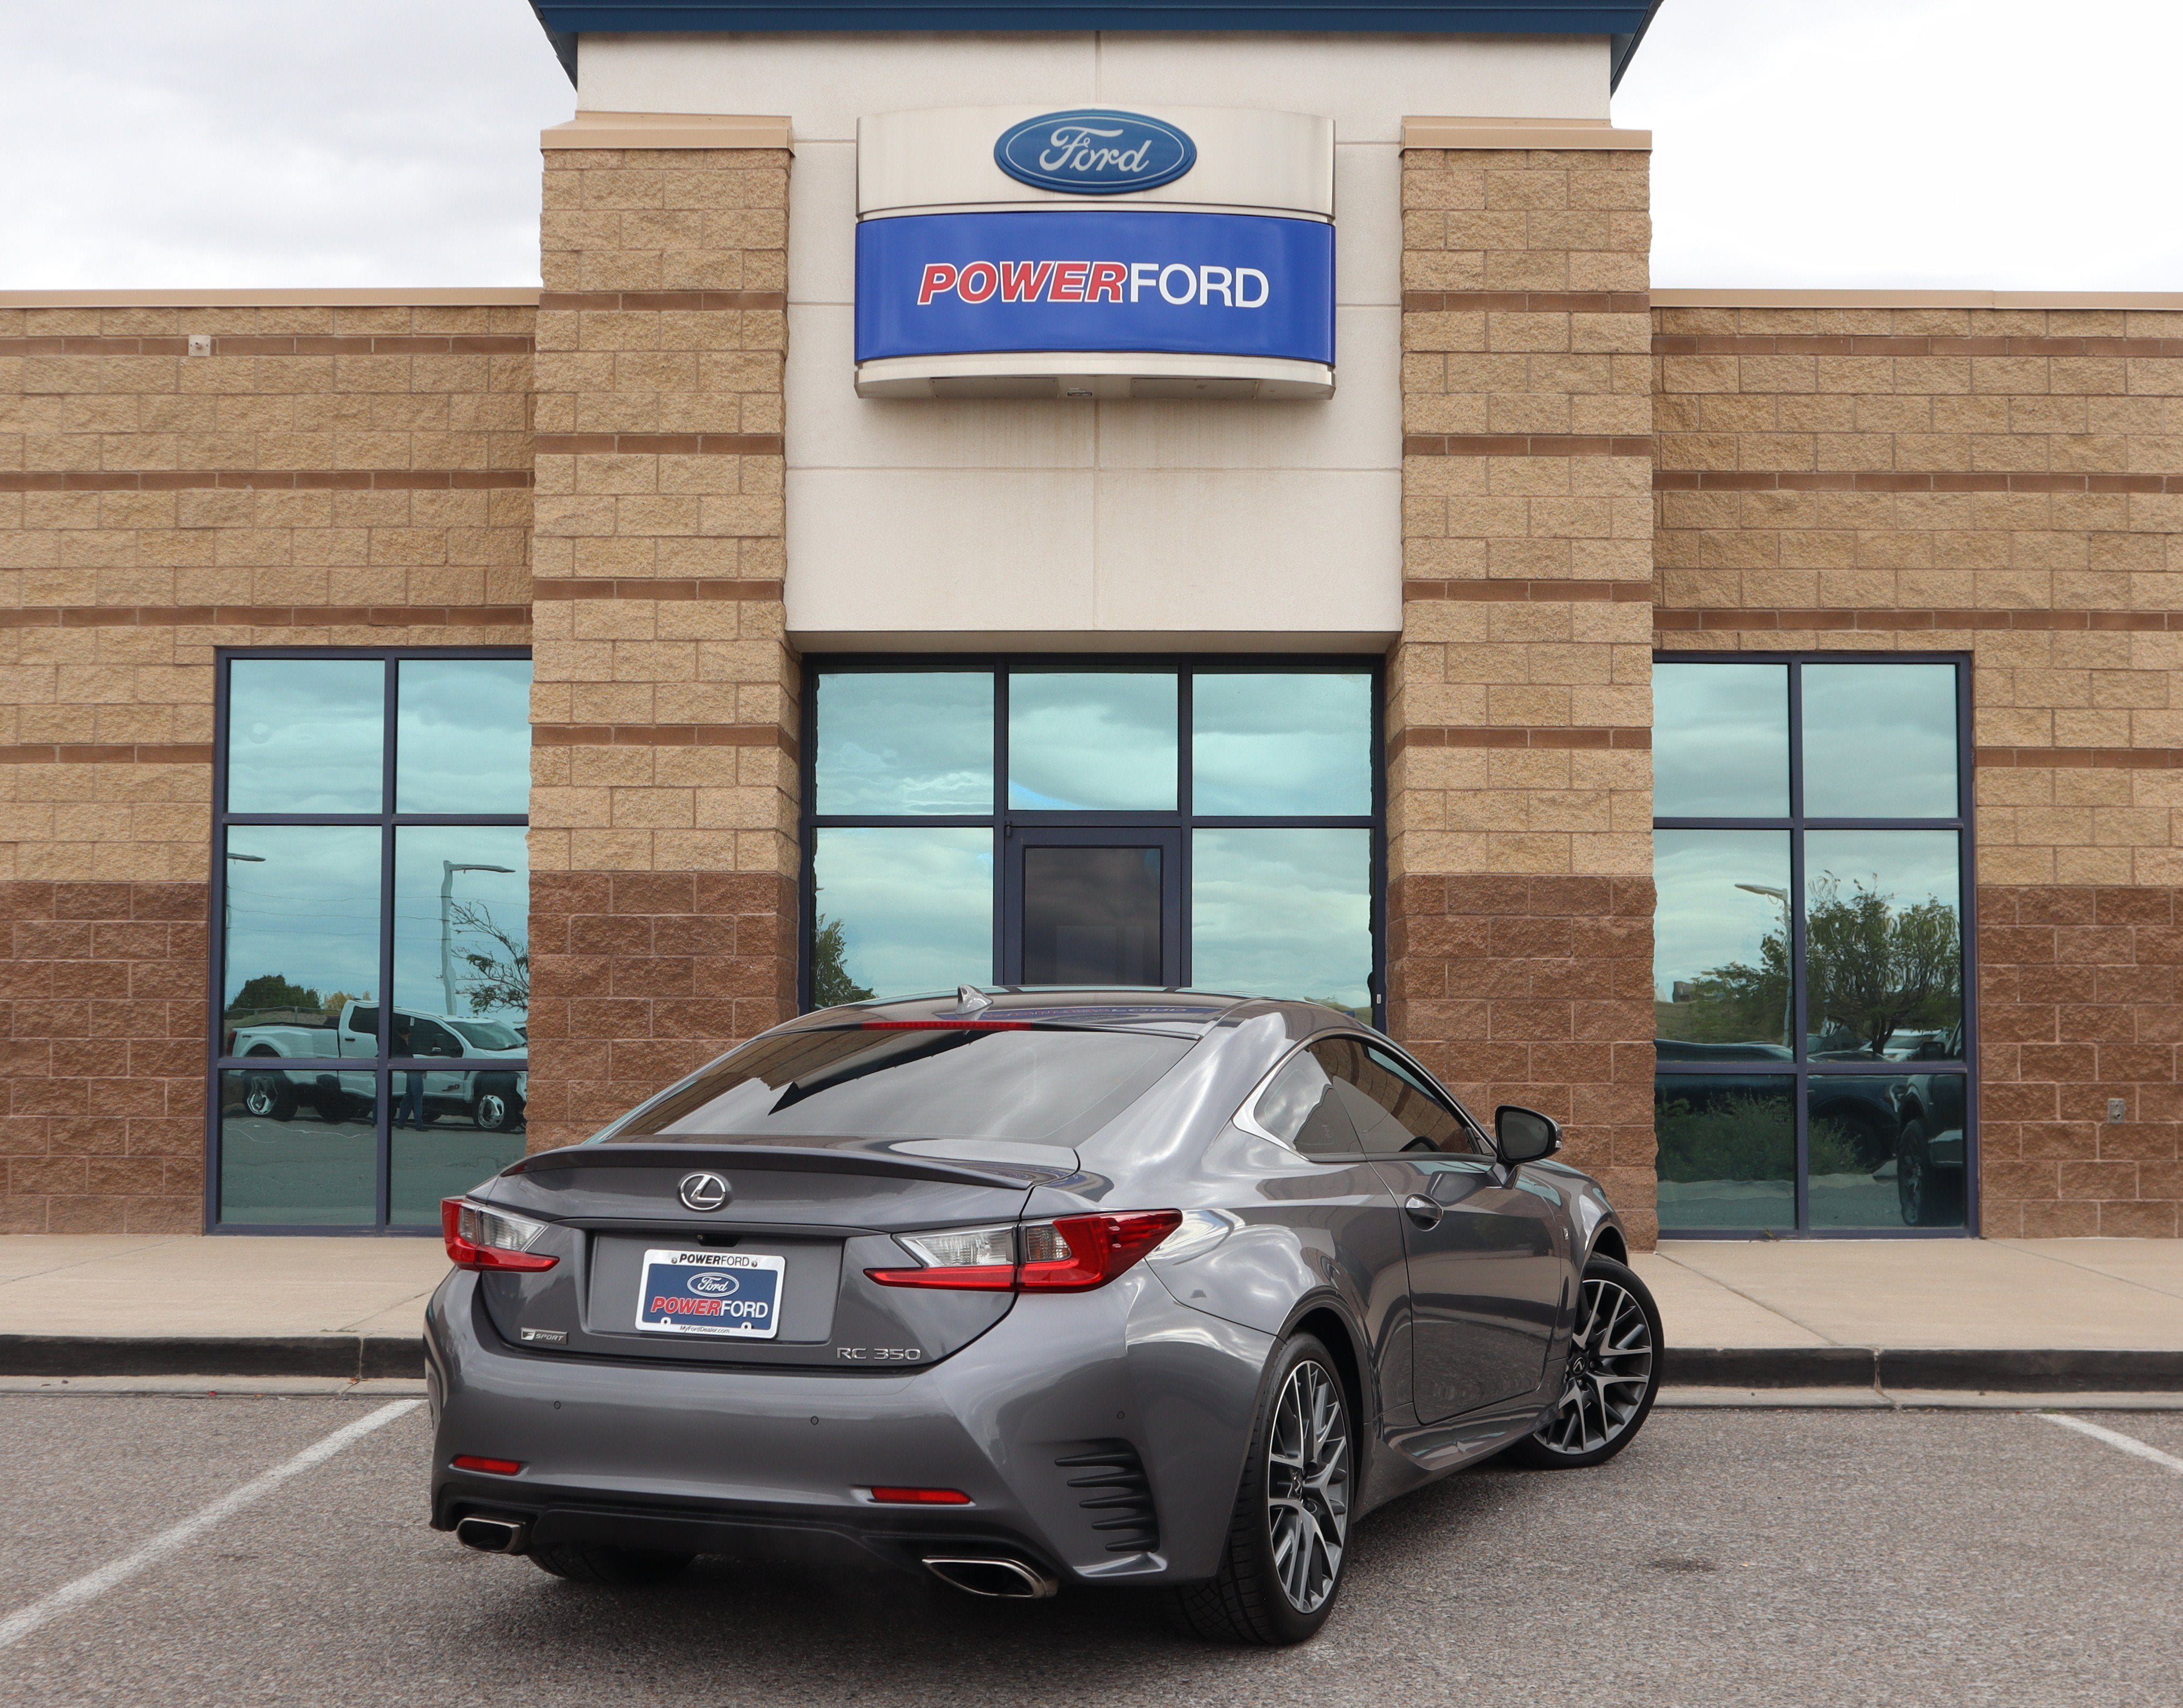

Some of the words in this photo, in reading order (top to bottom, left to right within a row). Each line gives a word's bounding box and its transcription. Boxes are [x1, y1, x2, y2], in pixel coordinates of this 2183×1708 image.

[1039, 126, 1151, 173] Ford
[917, 261, 1270, 308] POWERFORD
[679, 1253, 749, 1267] POWERFORD
[697, 1276, 729, 1292] Ford
[650, 1296, 768, 1319] POWERFORD
[837, 1347, 867, 1359] RC
[874, 1348, 921, 1360] 350
